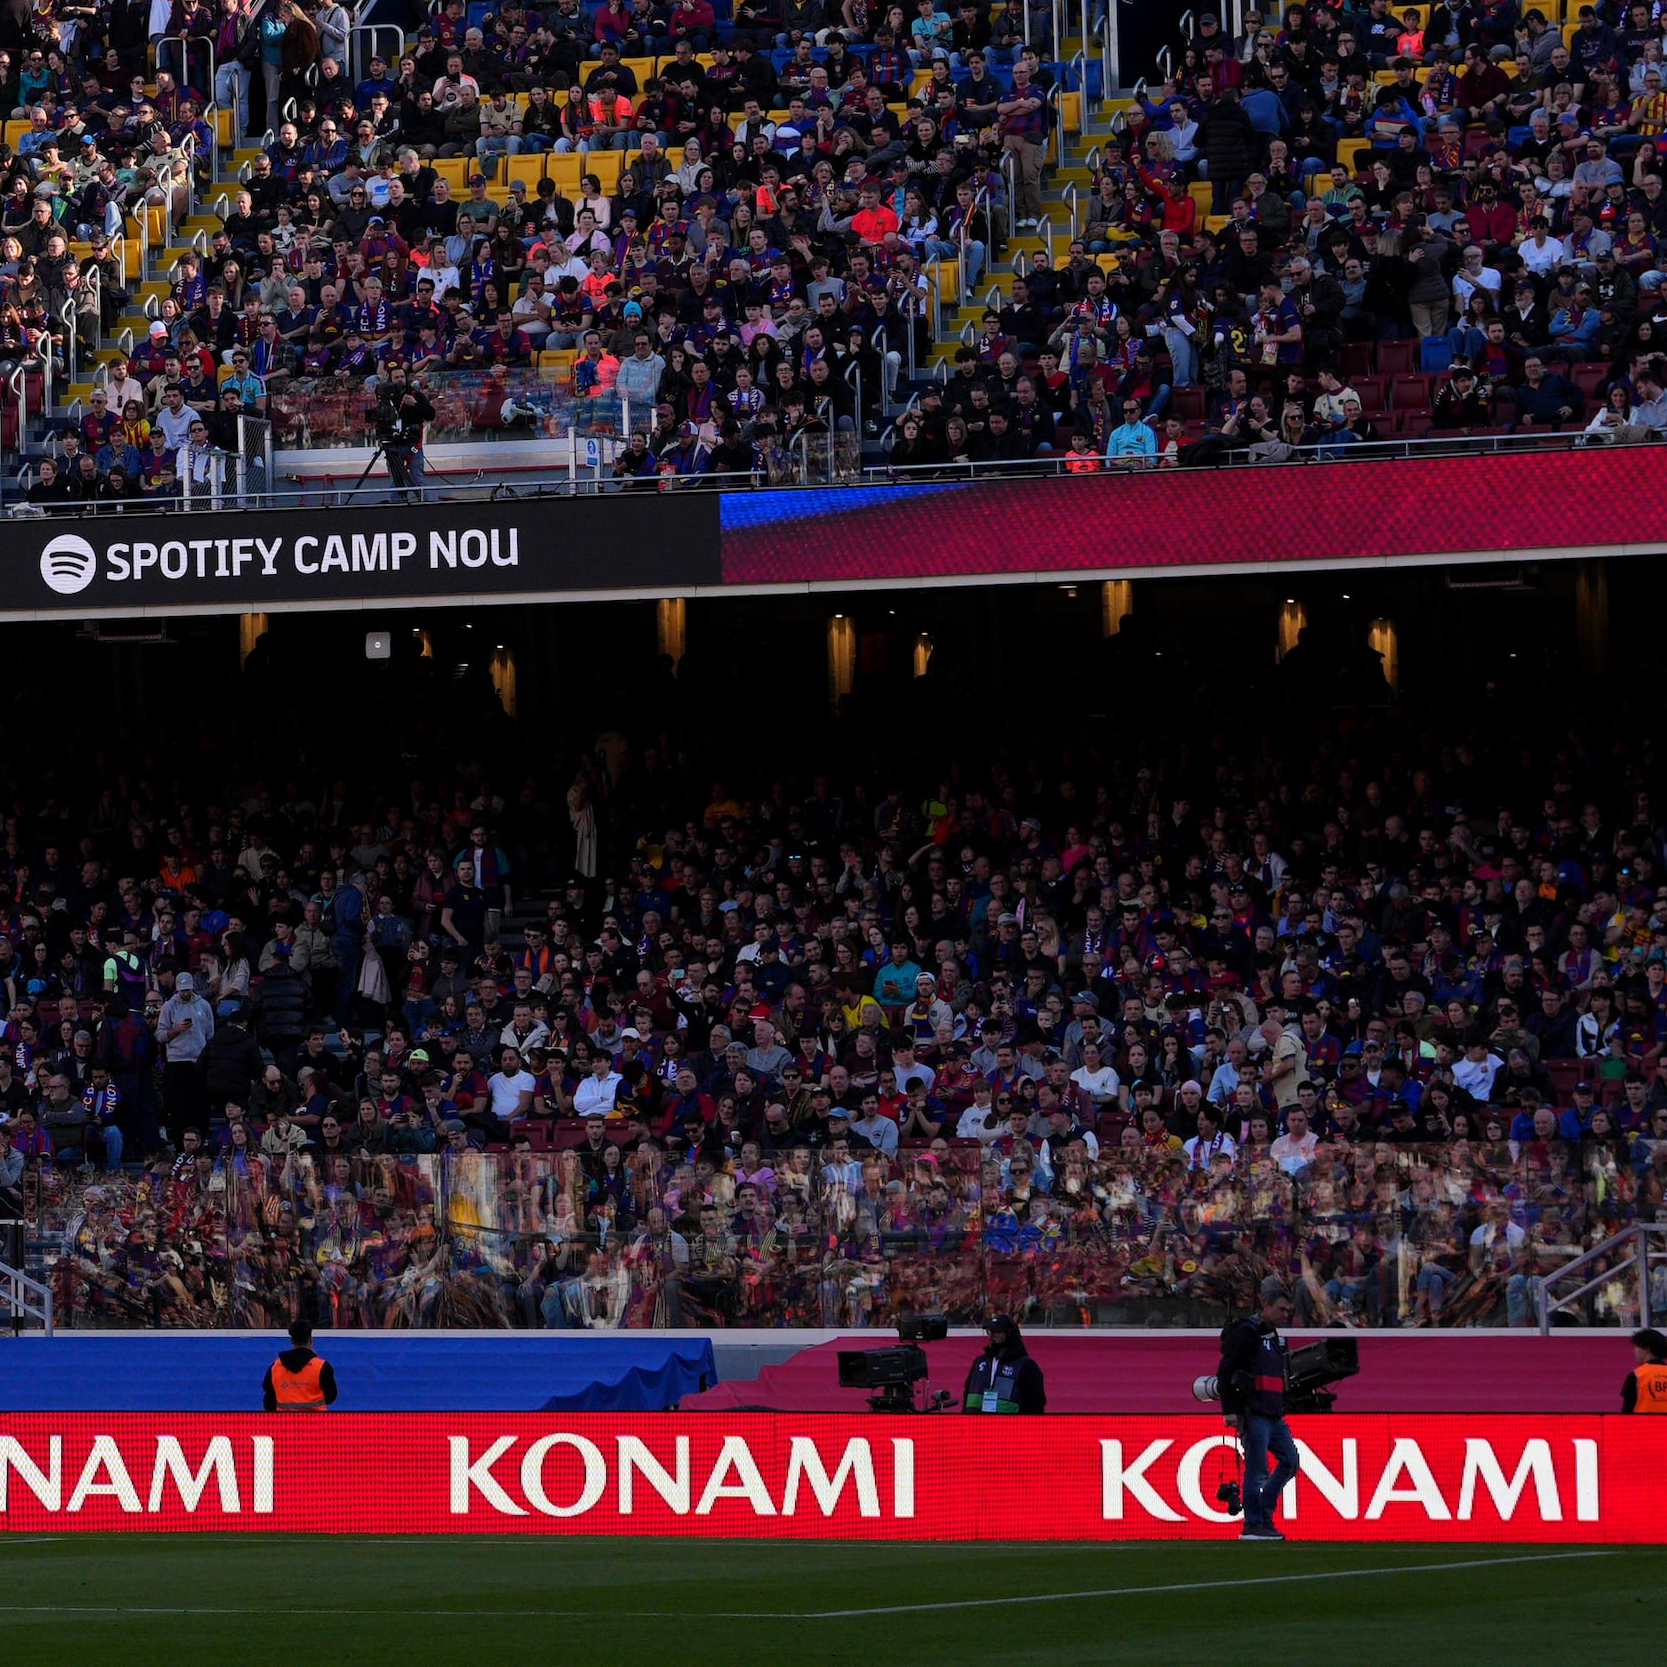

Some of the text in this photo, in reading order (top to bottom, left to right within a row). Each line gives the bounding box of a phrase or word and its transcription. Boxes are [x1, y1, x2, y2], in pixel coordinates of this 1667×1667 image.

[106, 527, 520, 582] SPOTIFY CAMP NOU
[449, 1432, 915, 1518] KONAMI
[1100, 1435, 1599, 1522] KONAMI
